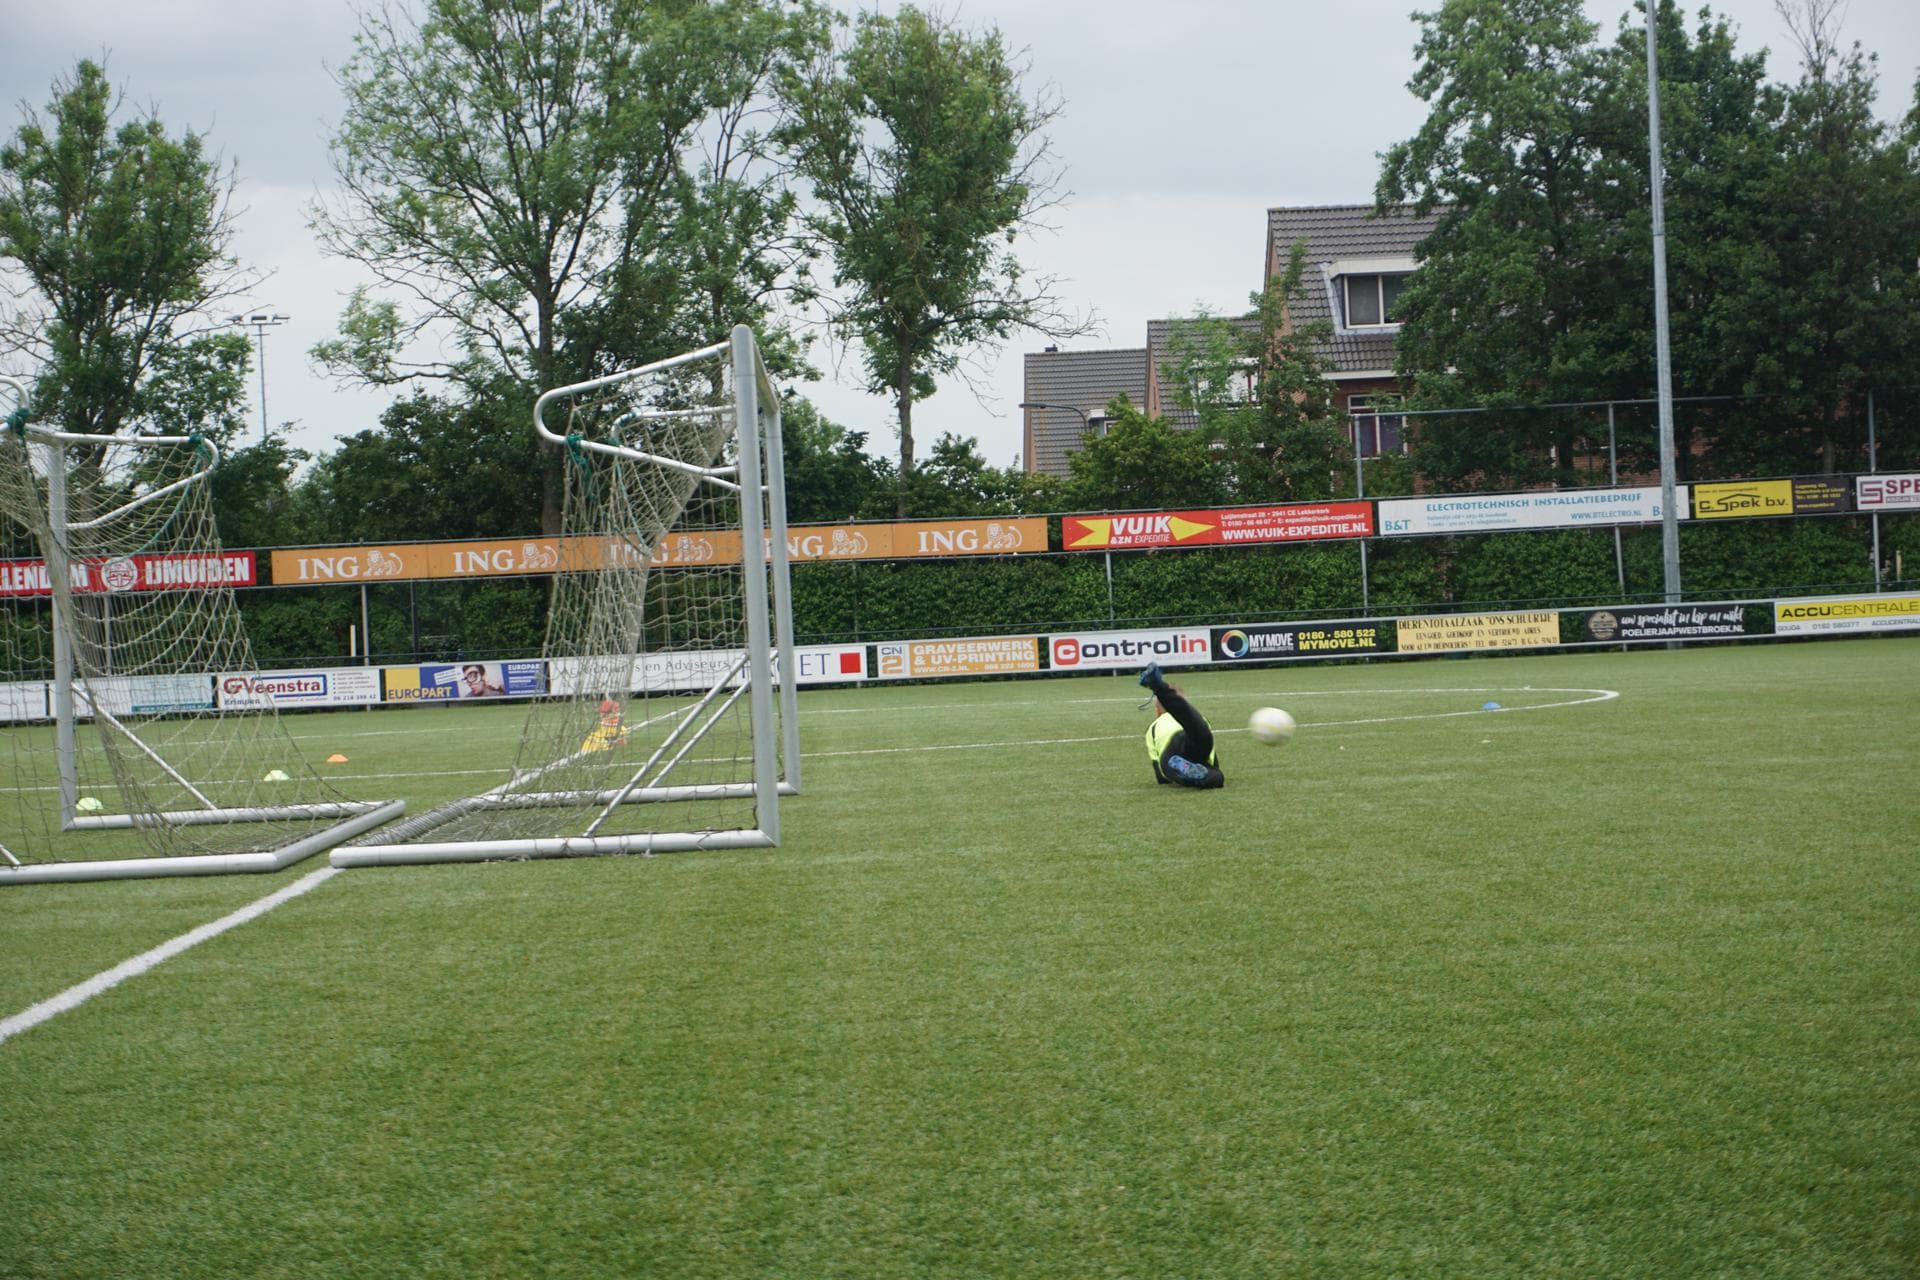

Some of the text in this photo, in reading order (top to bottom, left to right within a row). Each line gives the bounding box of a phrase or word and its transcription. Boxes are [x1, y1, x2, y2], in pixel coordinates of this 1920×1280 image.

[1426, 493, 1643, 512] ELECTROTECHNISCH INSTALLATIEBEDRIJF
[1111, 515, 1171, 535] VUIK
[1222, 522, 1369, 540] WWW.VUIK-EXPEDITIE.NL
[1384, 519, 1410, 531] B&T
[918, 529, 978, 553] ING
[1110, 533, 1170, 545] &ZN EXPEDITIE
[298, 556, 359, 579] ING
[453, 550, 513, 573] ING
[0, 562, 89, 592] LENDM
[145, 557, 249, 586] IJMUIDEN
[1781, 601, 1920, 618] ACCUCENTRALE
[1298, 631, 1325, 641] 0180
[1334, 629, 1353, 639] 580
[1356, 628, 1376, 638] 522
[881, 646, 902, 656] CN
[914, 640, 1034, 655] GRAVEERWERK
[1299, 637, 1377, 650] MYMOVE.NL
[645, 663, 661, 672] en
[666, 659, 730, 670] Adviseurs
[881, 656, 903, 674] 2
[914, 650, 1034, 666] & UV-PRINTING
[387, 686, 452, 701] EUROPART
